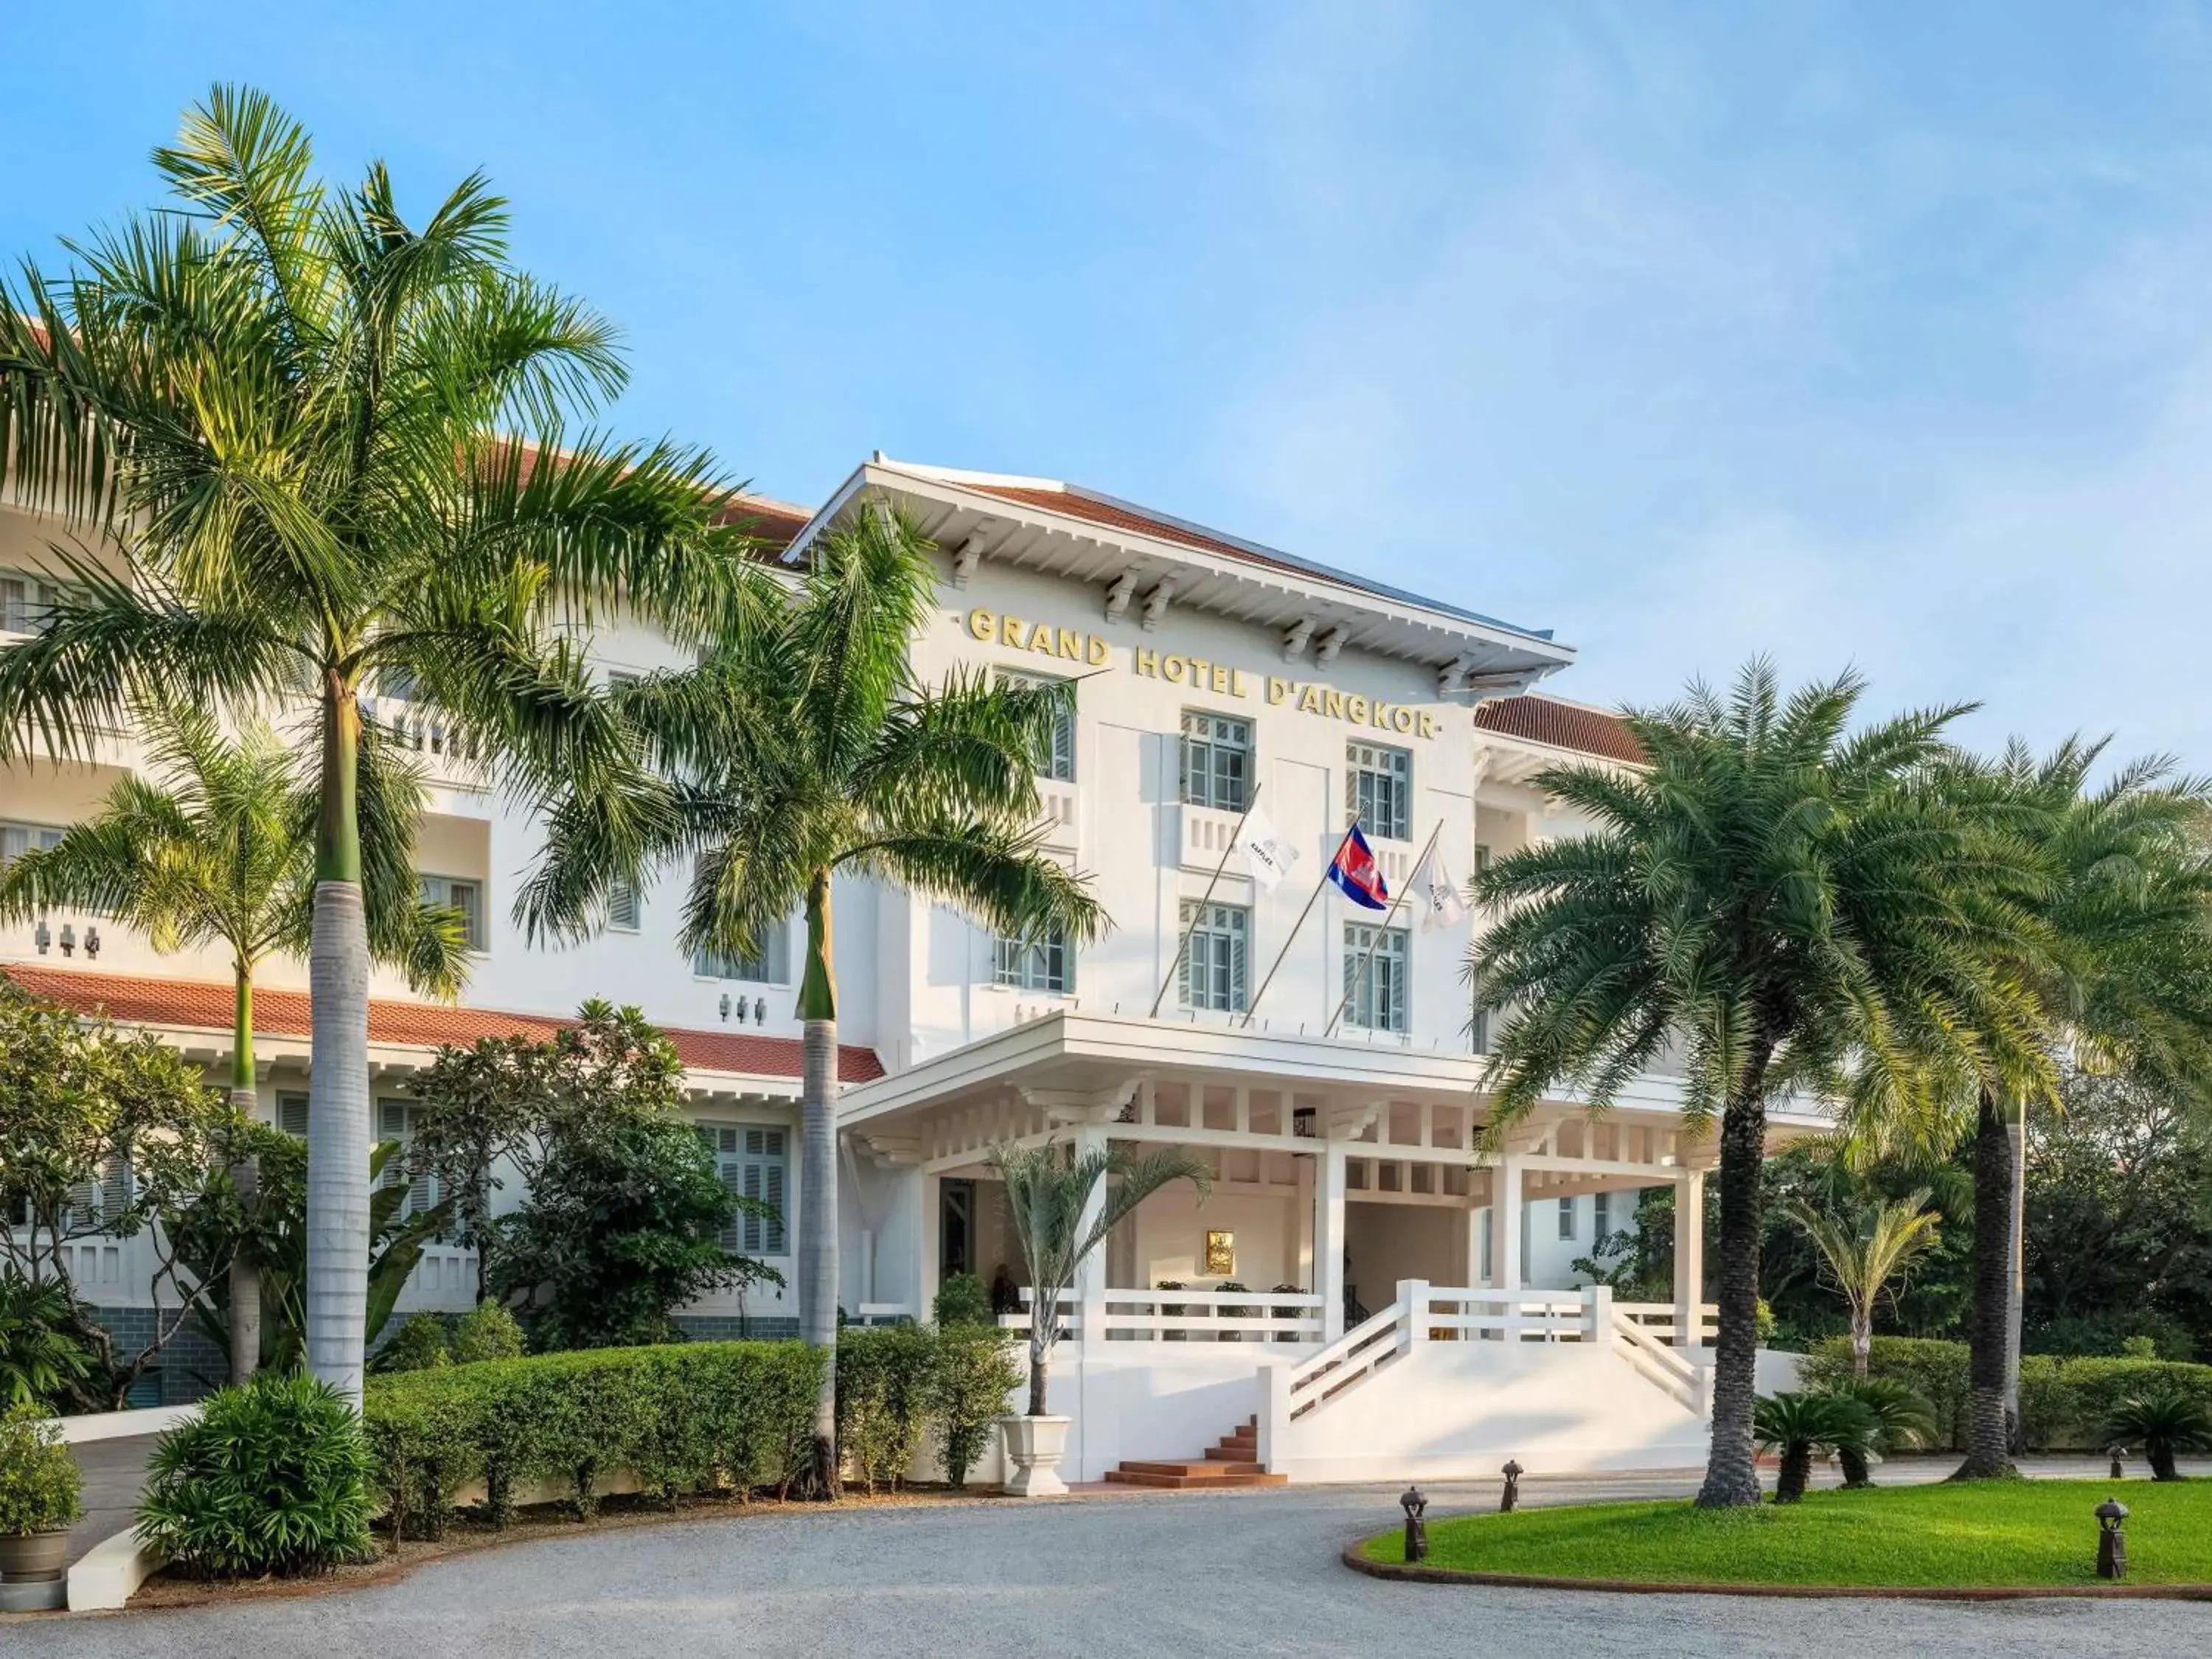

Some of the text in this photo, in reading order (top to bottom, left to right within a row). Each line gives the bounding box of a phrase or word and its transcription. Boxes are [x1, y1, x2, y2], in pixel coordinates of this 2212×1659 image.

[969, 607, 1436, 740] GRAND HOTEL D'ANGKOR
